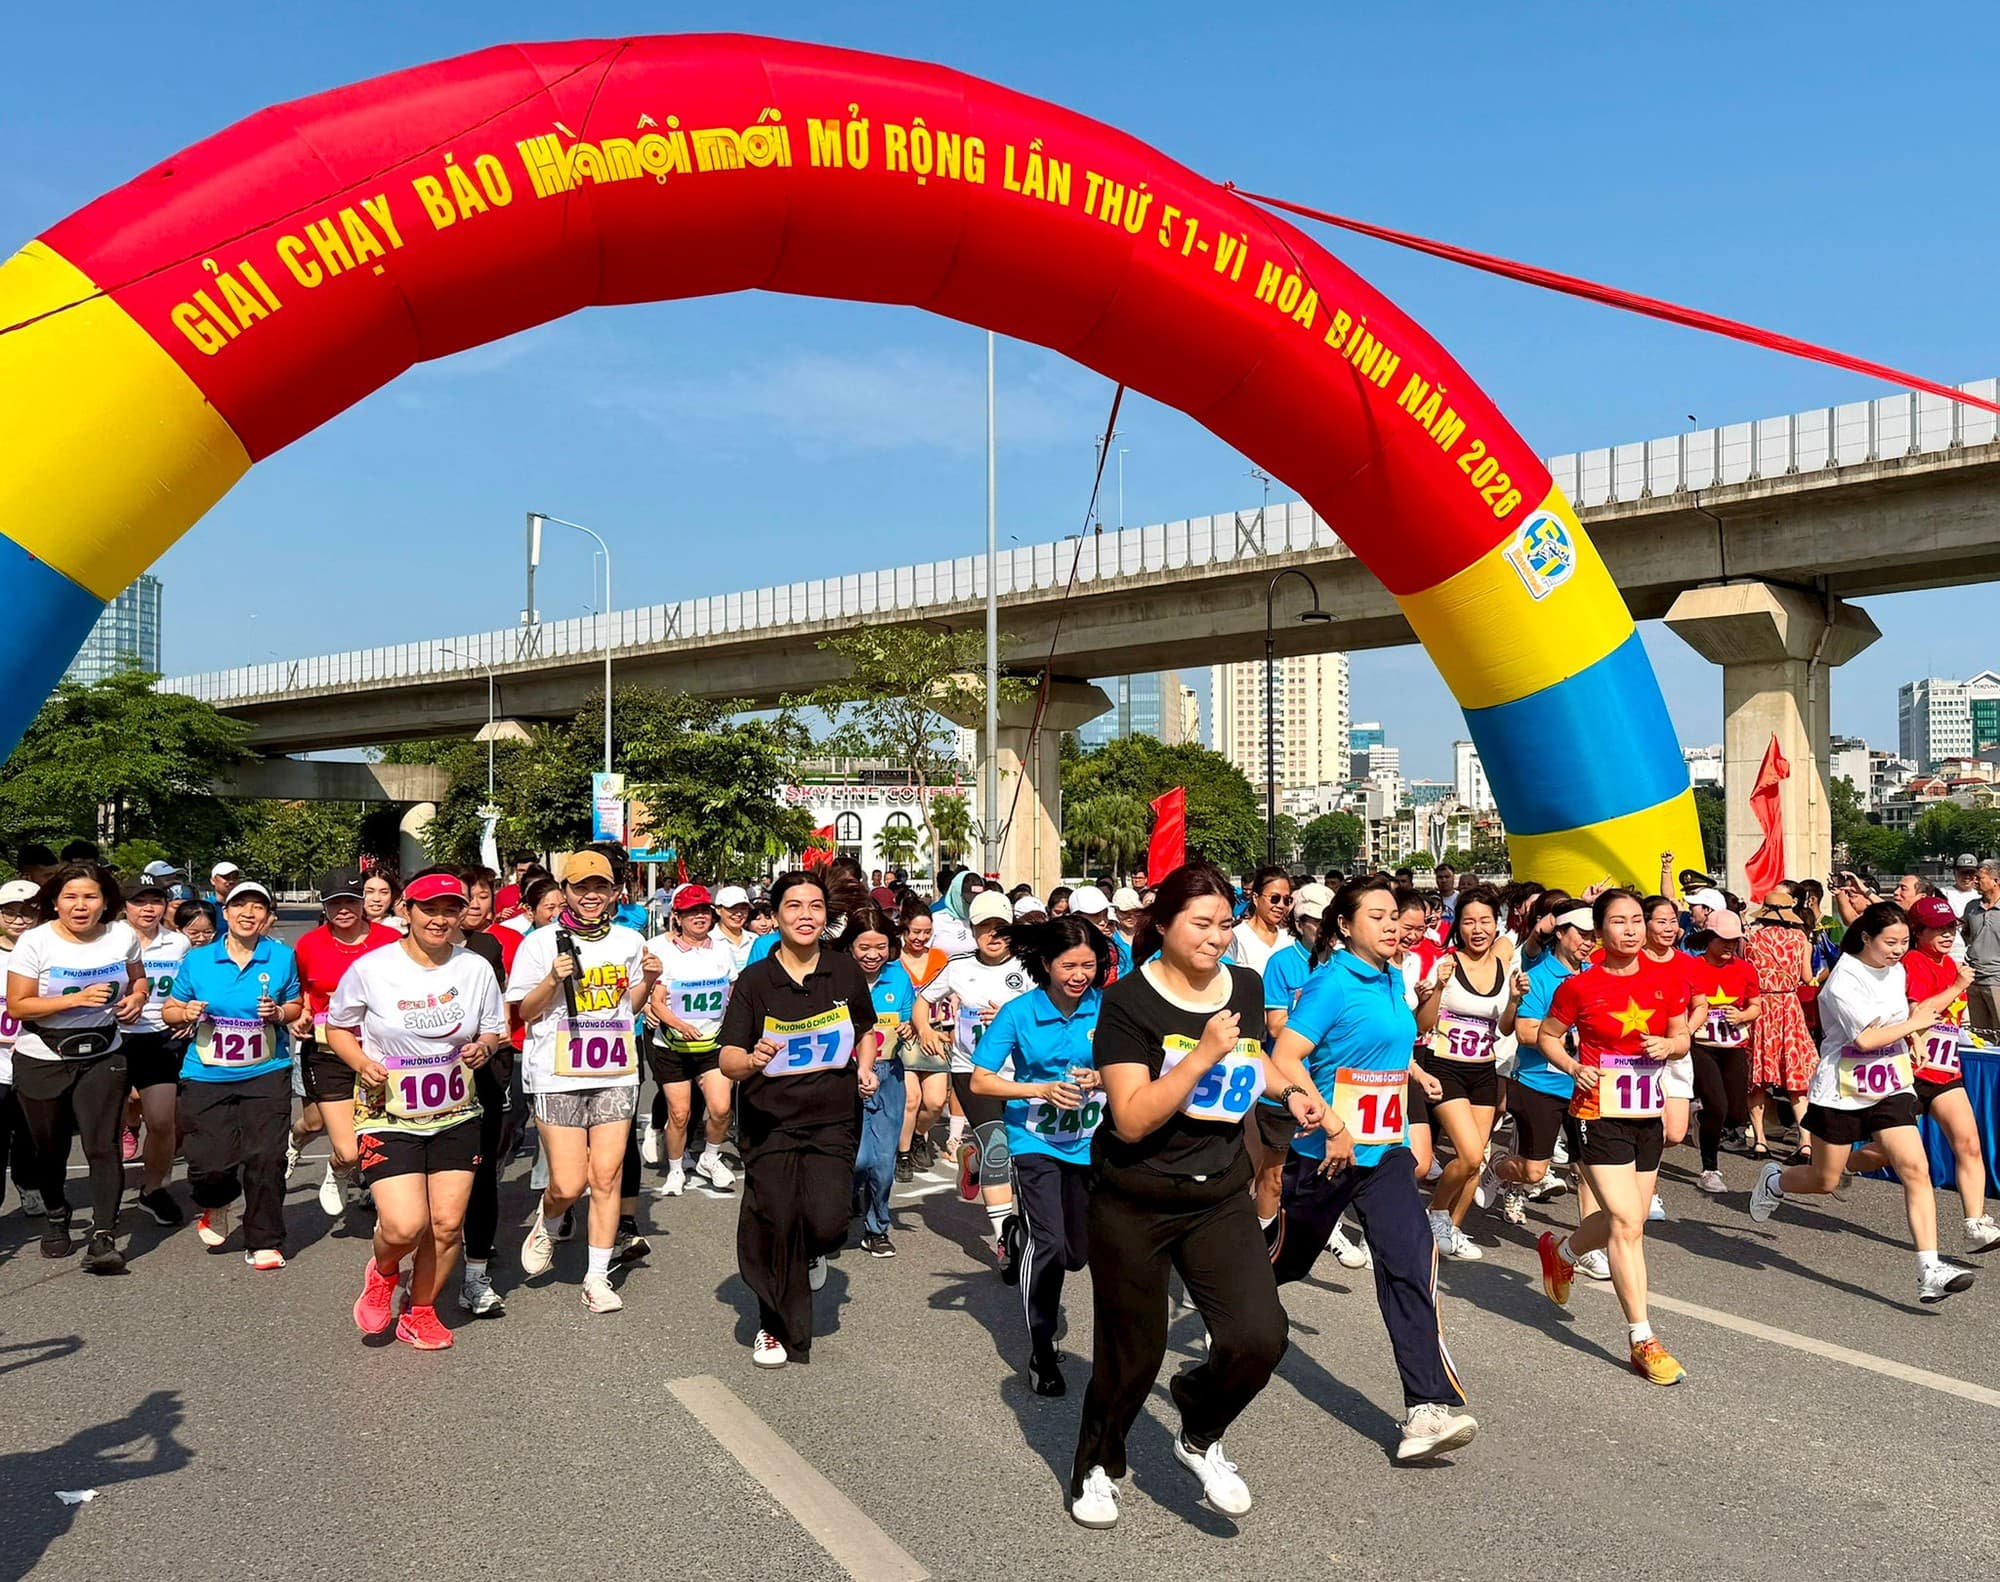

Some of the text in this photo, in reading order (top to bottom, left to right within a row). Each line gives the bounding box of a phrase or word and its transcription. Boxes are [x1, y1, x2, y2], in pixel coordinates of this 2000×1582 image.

[170, 258, 283, 356] GIẢI
[276, 193, 404, 288] CHẠY
[411, 152, 513, 230] BÁO
[807, 103, 870, 170] MỞ
[884, 117, 985, 185] RỘNG
[1003, 137, 1071, 206] LẦN
[1083, 171, 1153, 234] THỨ
[1254, 260, 1319, 330] HÒA
[1324, 308, 1400, 389] BÌNH
[1396, 372, 1466, 453] NĂM
[1456, 438, 1522, 519] 2026
[786, 785, 879, 800] SKYLINE
[681, 991, 723, 1012] 142
[775, 1022, 805, 1031] PHƯỜNG
[212, 1032, 262, 1060] 121
[568, 1036, 628, 1069] 104
[788, 1030, 840, 1067] 57
[400, 1065, 465, 1110] 106
[1192, 1063, 1256, 1113] 58
[1035, 1101, 1101, 1135] 240
[1357, 1094, 1403, 1134] 14
